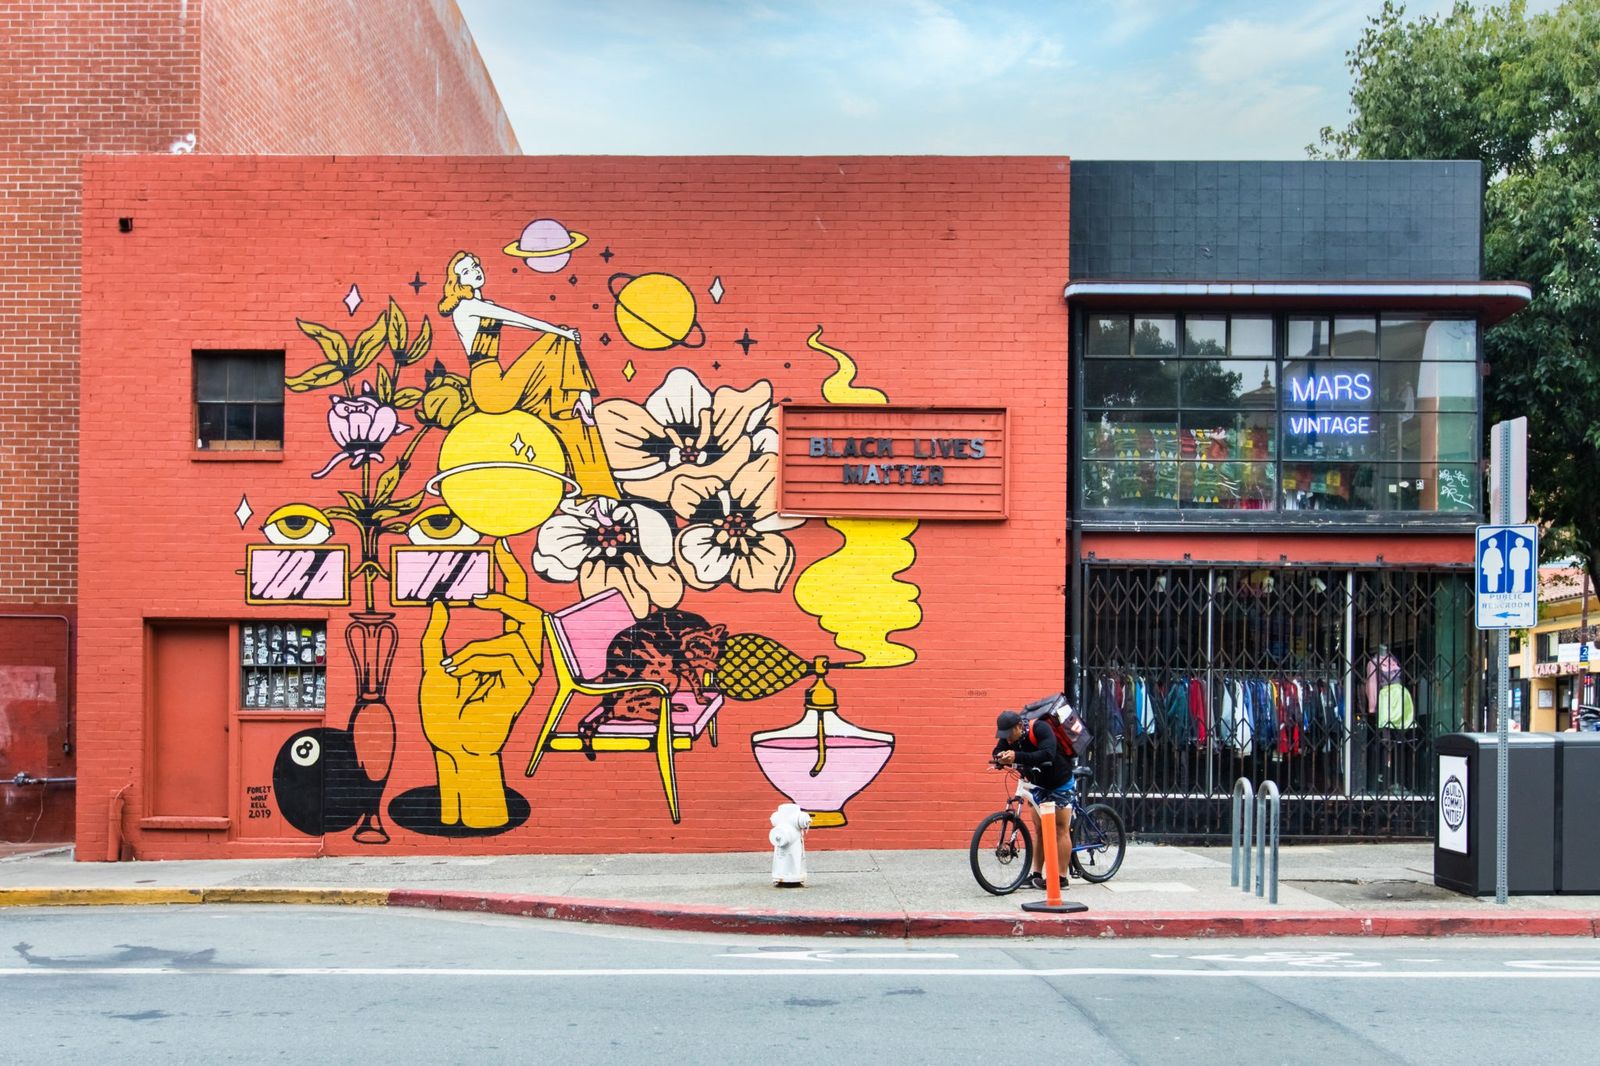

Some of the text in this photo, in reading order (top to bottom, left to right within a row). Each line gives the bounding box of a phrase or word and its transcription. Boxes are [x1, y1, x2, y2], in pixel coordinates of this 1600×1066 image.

[1291, 373, 1372, 402] MARS
[1290, 416, 1370, 434] VINTAGE
[809, 437, 986, 460] BLACK LIVES
[842, 463, 945, 486] MATTER
[296, 741, 313, 759] 8
[248, 809, 272, 819] 2019
